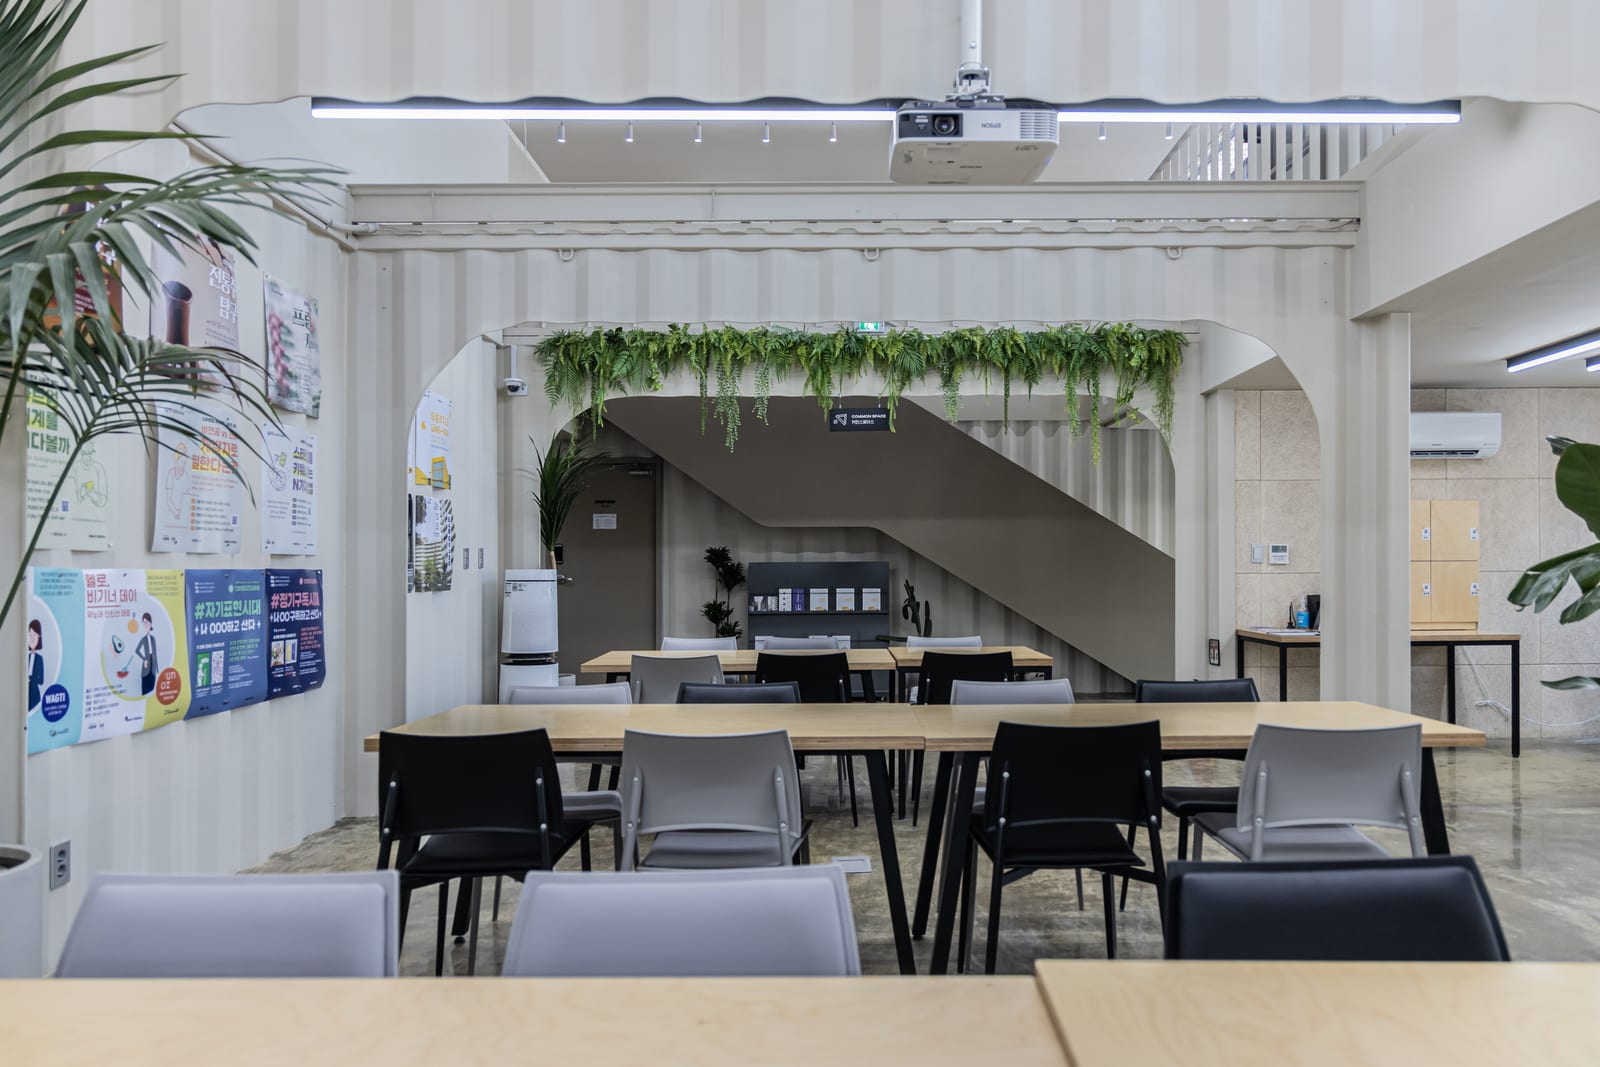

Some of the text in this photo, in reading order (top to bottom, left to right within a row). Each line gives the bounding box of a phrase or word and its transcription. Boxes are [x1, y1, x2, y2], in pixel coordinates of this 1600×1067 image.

[26, 407, 58, 431] 계를
[26, 430, 70, 455] 다볼까
[87, 588, 137, 603] 비기너 데이
[194, 599, 261, 619] #자기표현시대
